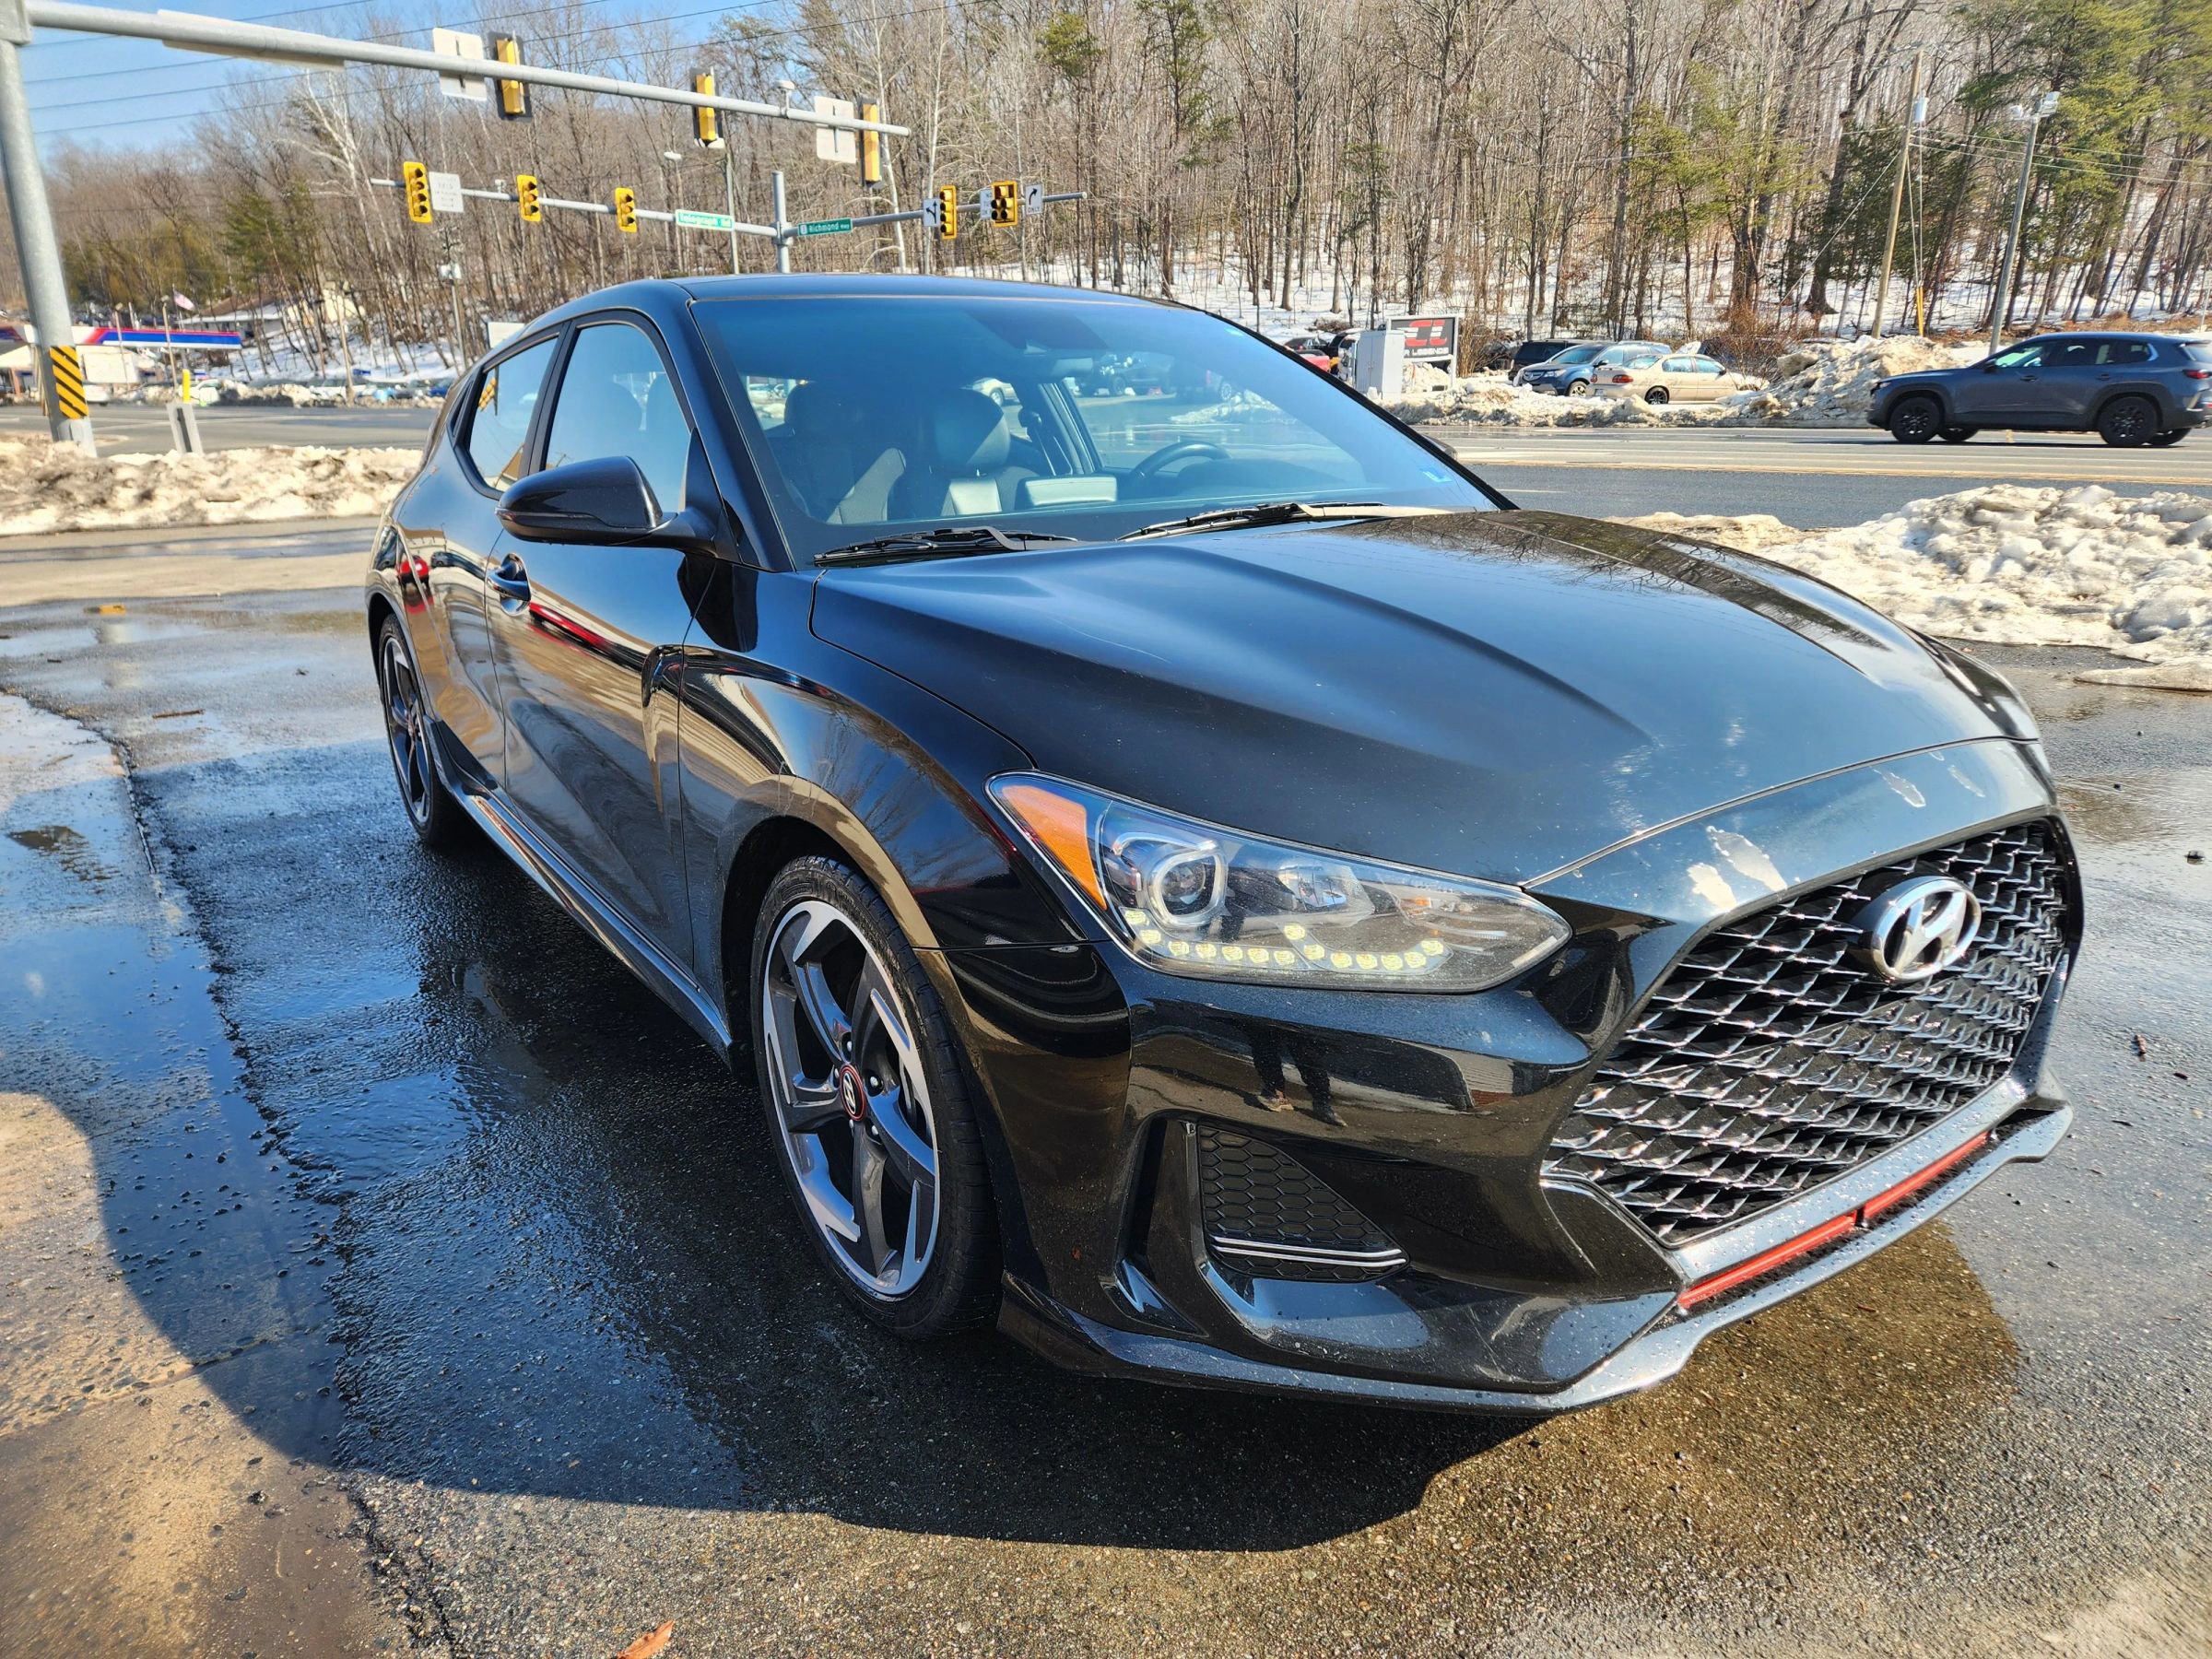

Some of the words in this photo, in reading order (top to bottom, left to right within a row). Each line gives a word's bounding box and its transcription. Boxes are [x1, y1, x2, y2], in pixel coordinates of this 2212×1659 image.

[1027, 206, 1041, 214] ONLY
[679, 213, 718, 227] Telegraph
[721, 218, 732, 228] Rd
[808, 222, 840, 233] Richmond
